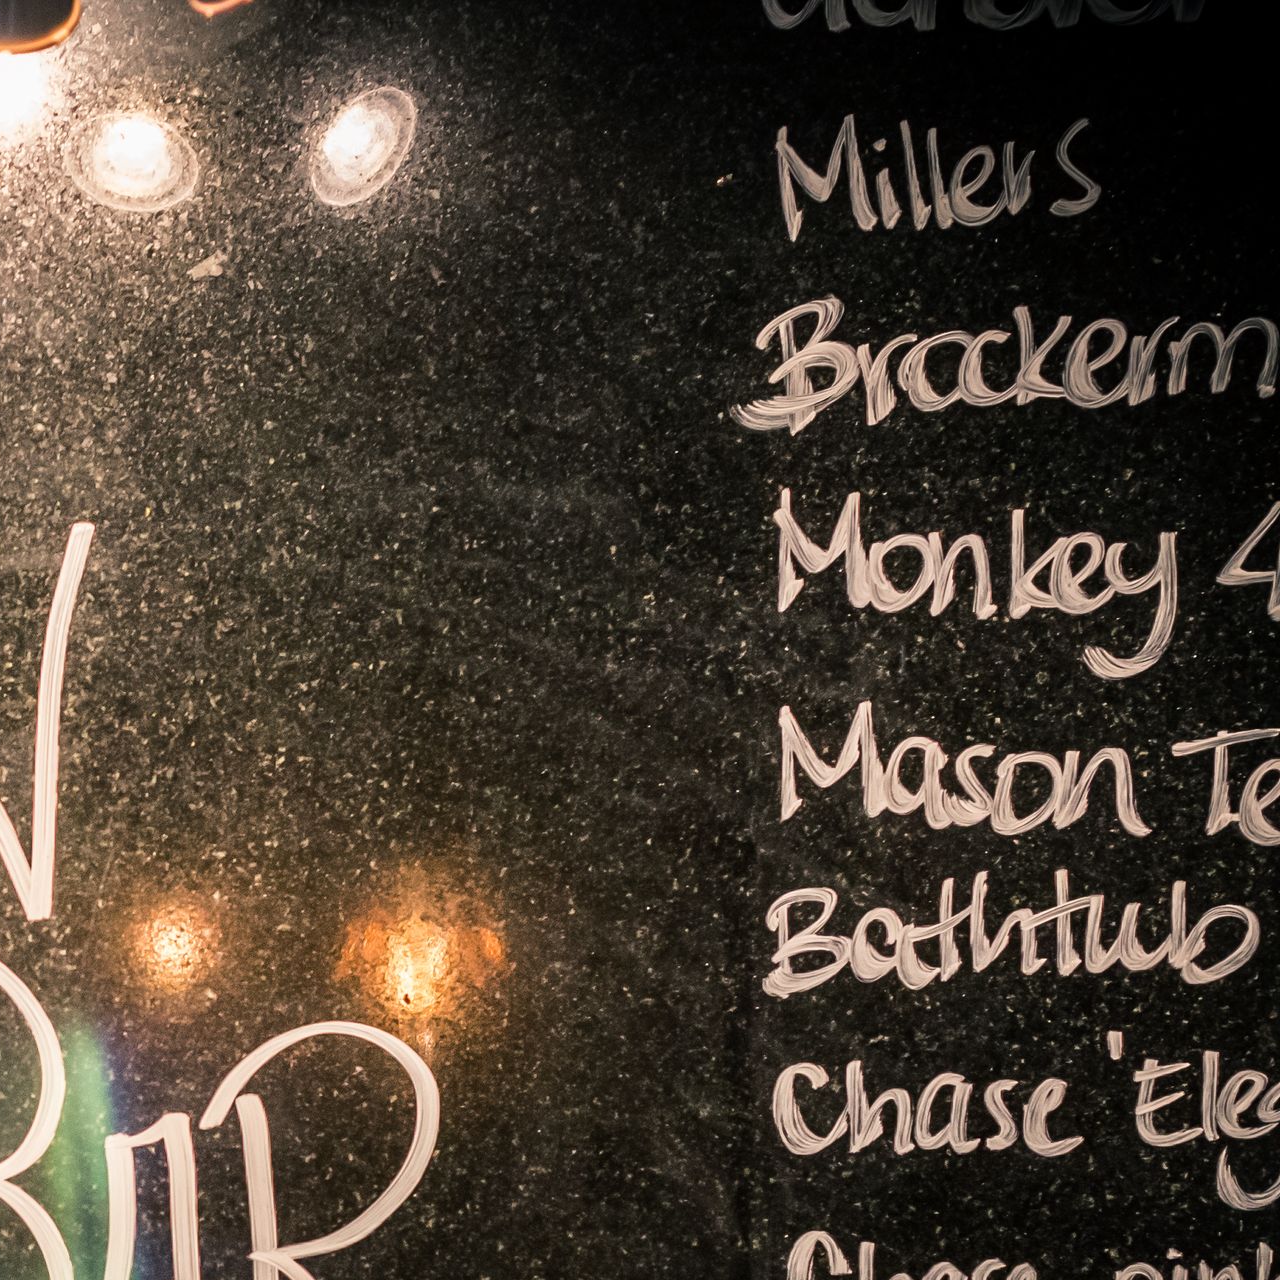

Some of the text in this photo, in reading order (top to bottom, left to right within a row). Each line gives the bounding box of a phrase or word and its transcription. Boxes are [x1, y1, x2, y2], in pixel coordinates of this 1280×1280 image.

[774, 113, 1100, 242] Millers
[773, 488, 1178, 680] Monkey
[778, 700, 1152, 836] Mason
[762, 868, 1261, 998] Bathtub
[773, 1060, 1085, 1158] Chase
